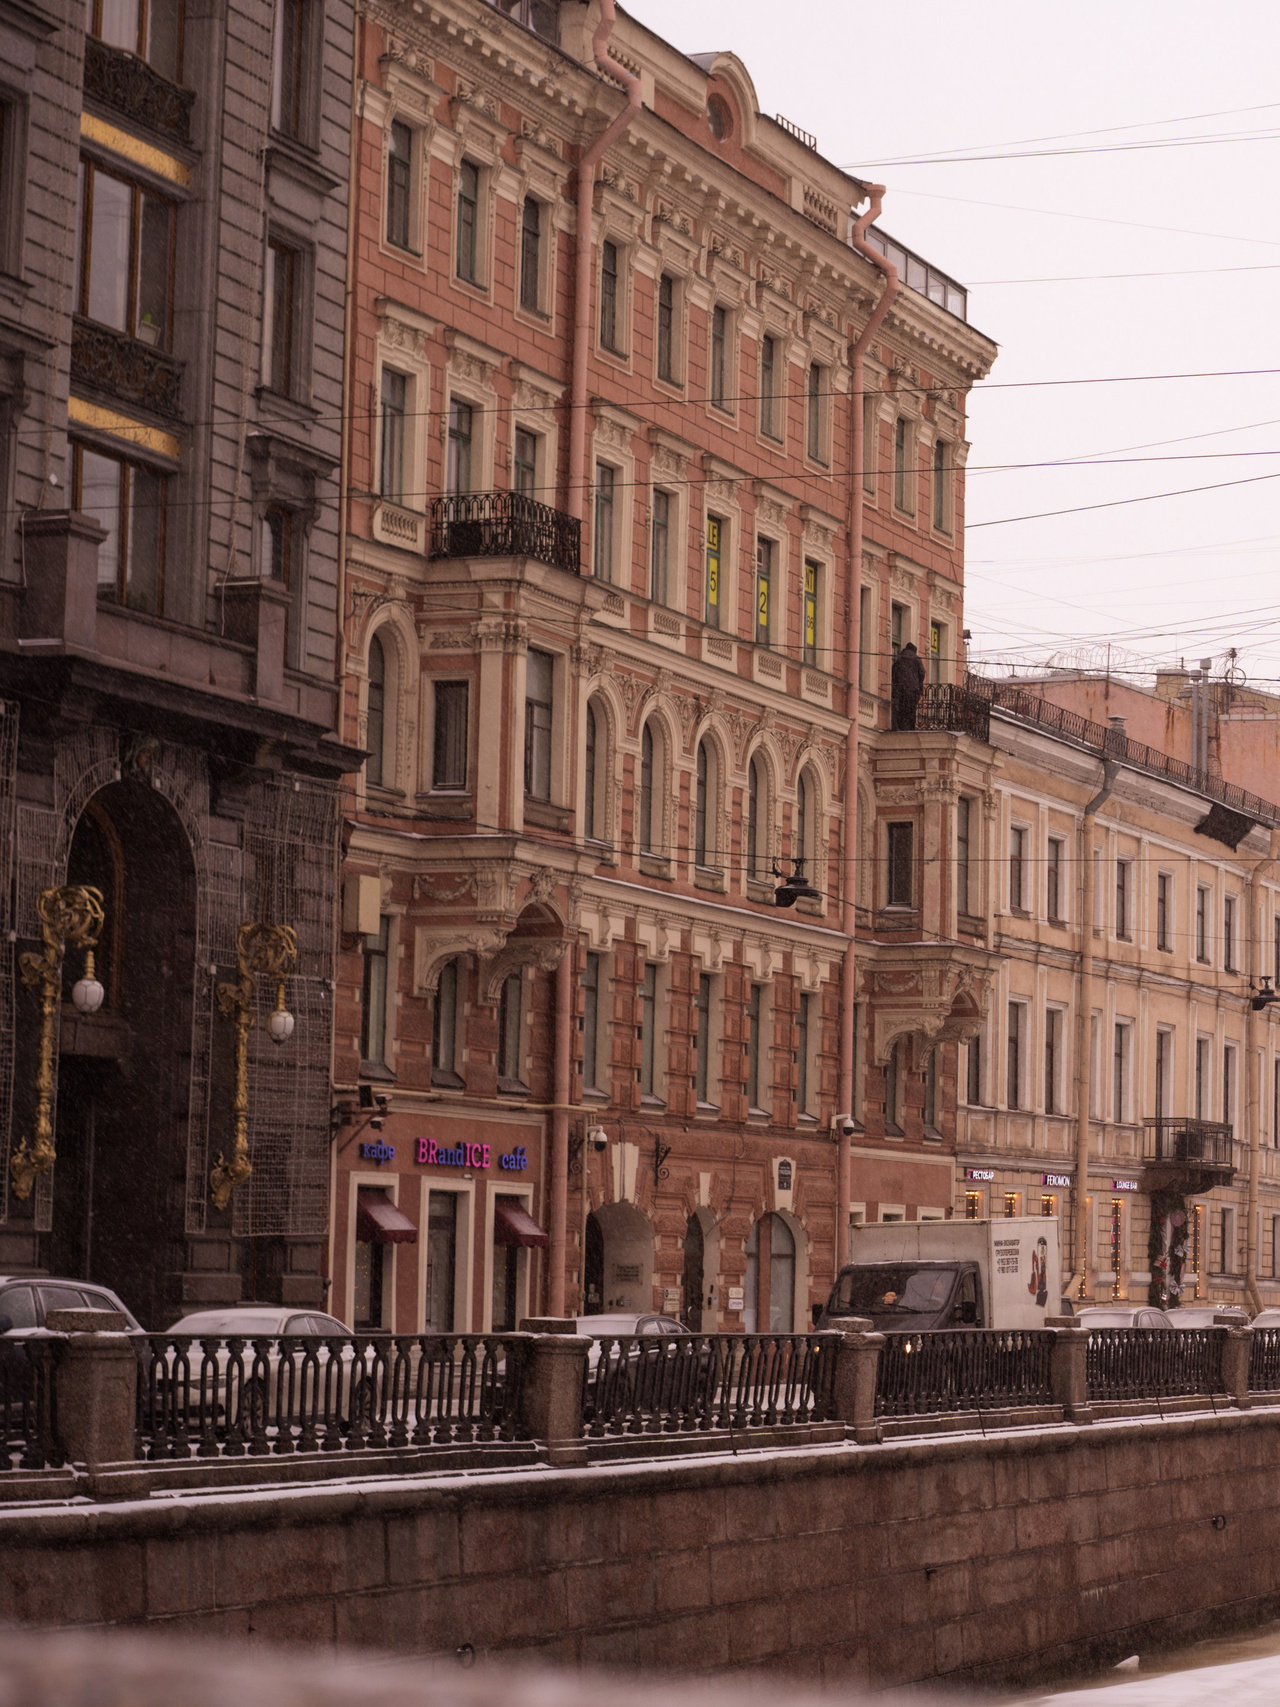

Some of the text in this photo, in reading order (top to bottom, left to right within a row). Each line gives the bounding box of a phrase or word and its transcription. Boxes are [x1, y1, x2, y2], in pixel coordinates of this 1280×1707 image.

[709, 571, 716, 592] 5
[759, 591, 767, 614] 2
[363, 1139, 395, 1164] кафе
[417, 1137, 491, 1169] BRandICE
[501, 1146, 528, 1170] café
[972, 1170, 995, 1180] РЕСТОБАР
[1047, 1175, 1070, 1187] FEROMON
